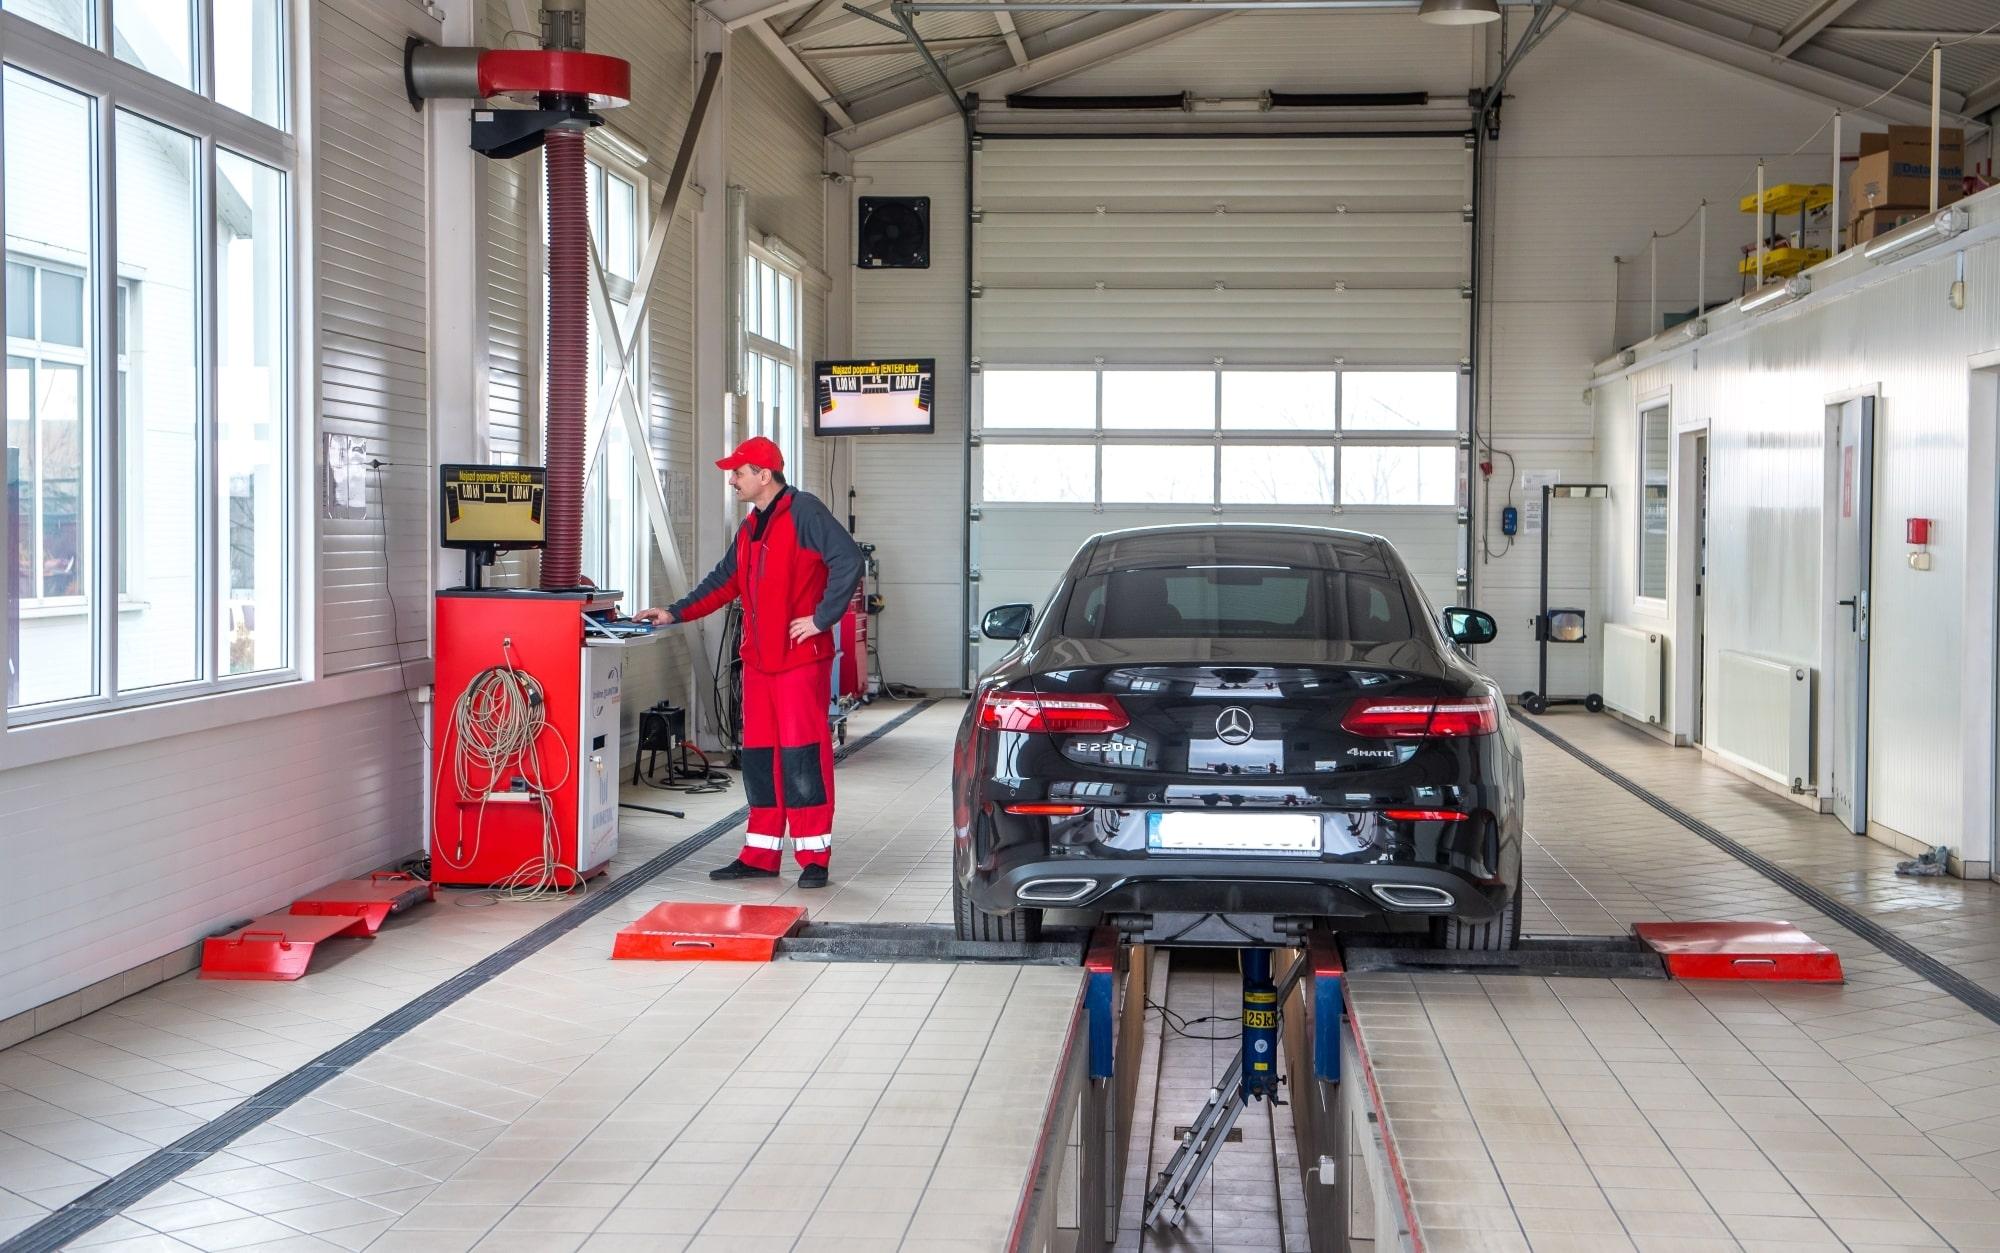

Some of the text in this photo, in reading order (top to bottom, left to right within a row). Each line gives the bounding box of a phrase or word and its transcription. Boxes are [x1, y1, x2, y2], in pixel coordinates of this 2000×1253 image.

[1903, 163, 1962, 176] Dataank
[906, 364, 919, 373] start
[1346, 747, 1395, 757] 4MATIC
